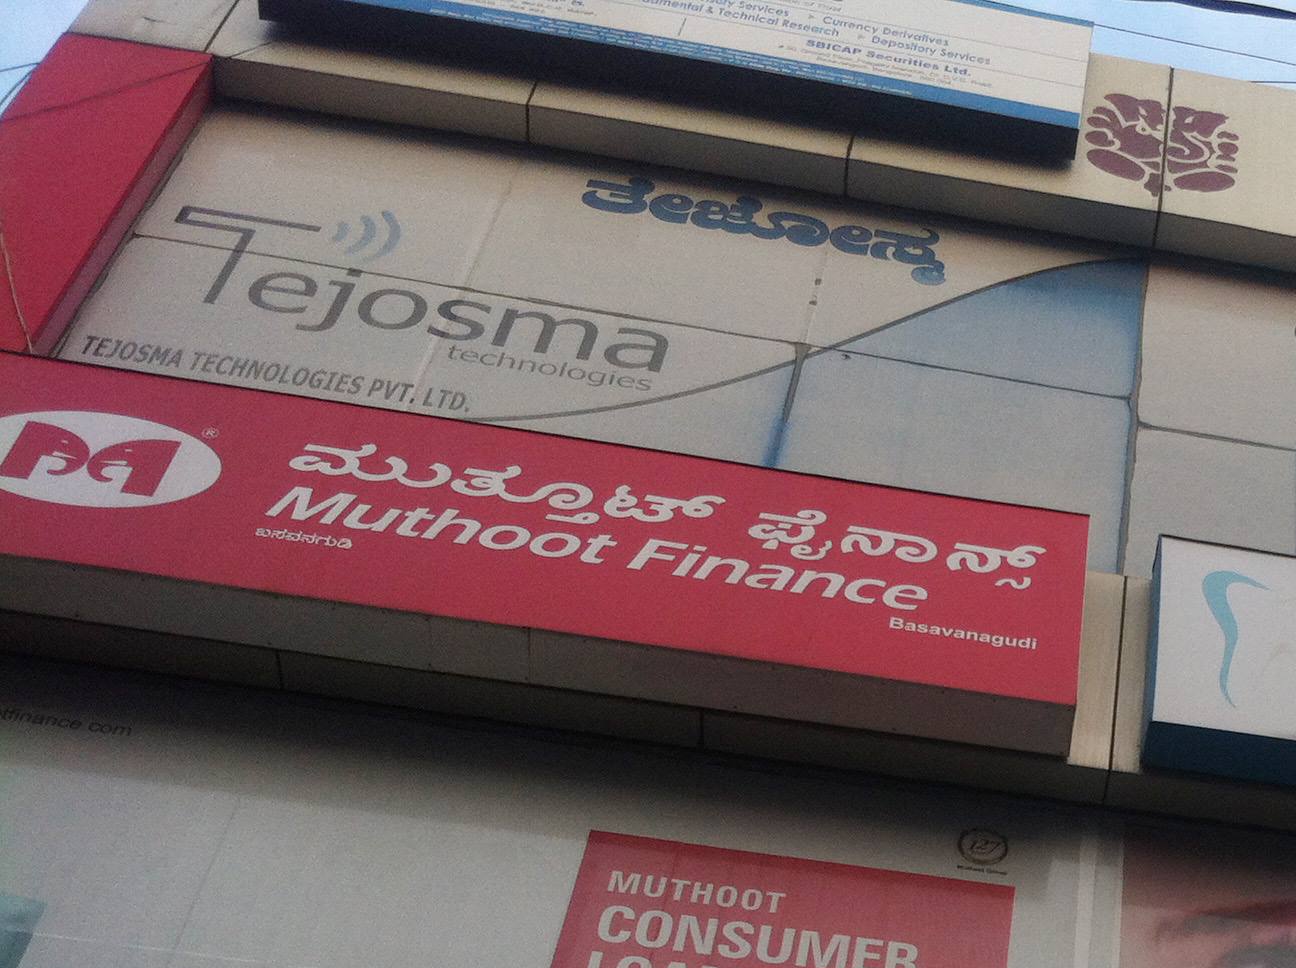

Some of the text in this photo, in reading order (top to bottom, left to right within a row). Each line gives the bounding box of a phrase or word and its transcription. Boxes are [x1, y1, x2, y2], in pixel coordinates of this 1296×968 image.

[719, 7, 780, 25] Technical
[782, 19, 840, 37] Research
[822, 15, 950, 46] Currency Derivatives
[806, 39, 862, 55] SBICAP
[866, 50, 940, 71] Securities
[944, 65, 973, 77] Ltd.
[871, 35, 992, 65] Depository Services
[174, 205, 670, 373] Tejosma
[80, 334, 471, 413] TEJOSMA TECHNOLOGIES PVT. LTD.
[446, 343, 654, 392] technologies
[265, 486, 928, 611] Muthoot Finance
[888, 616, 1038, 650] Basavanagudi
[607, 870, 786, 914] MUTHOOT
